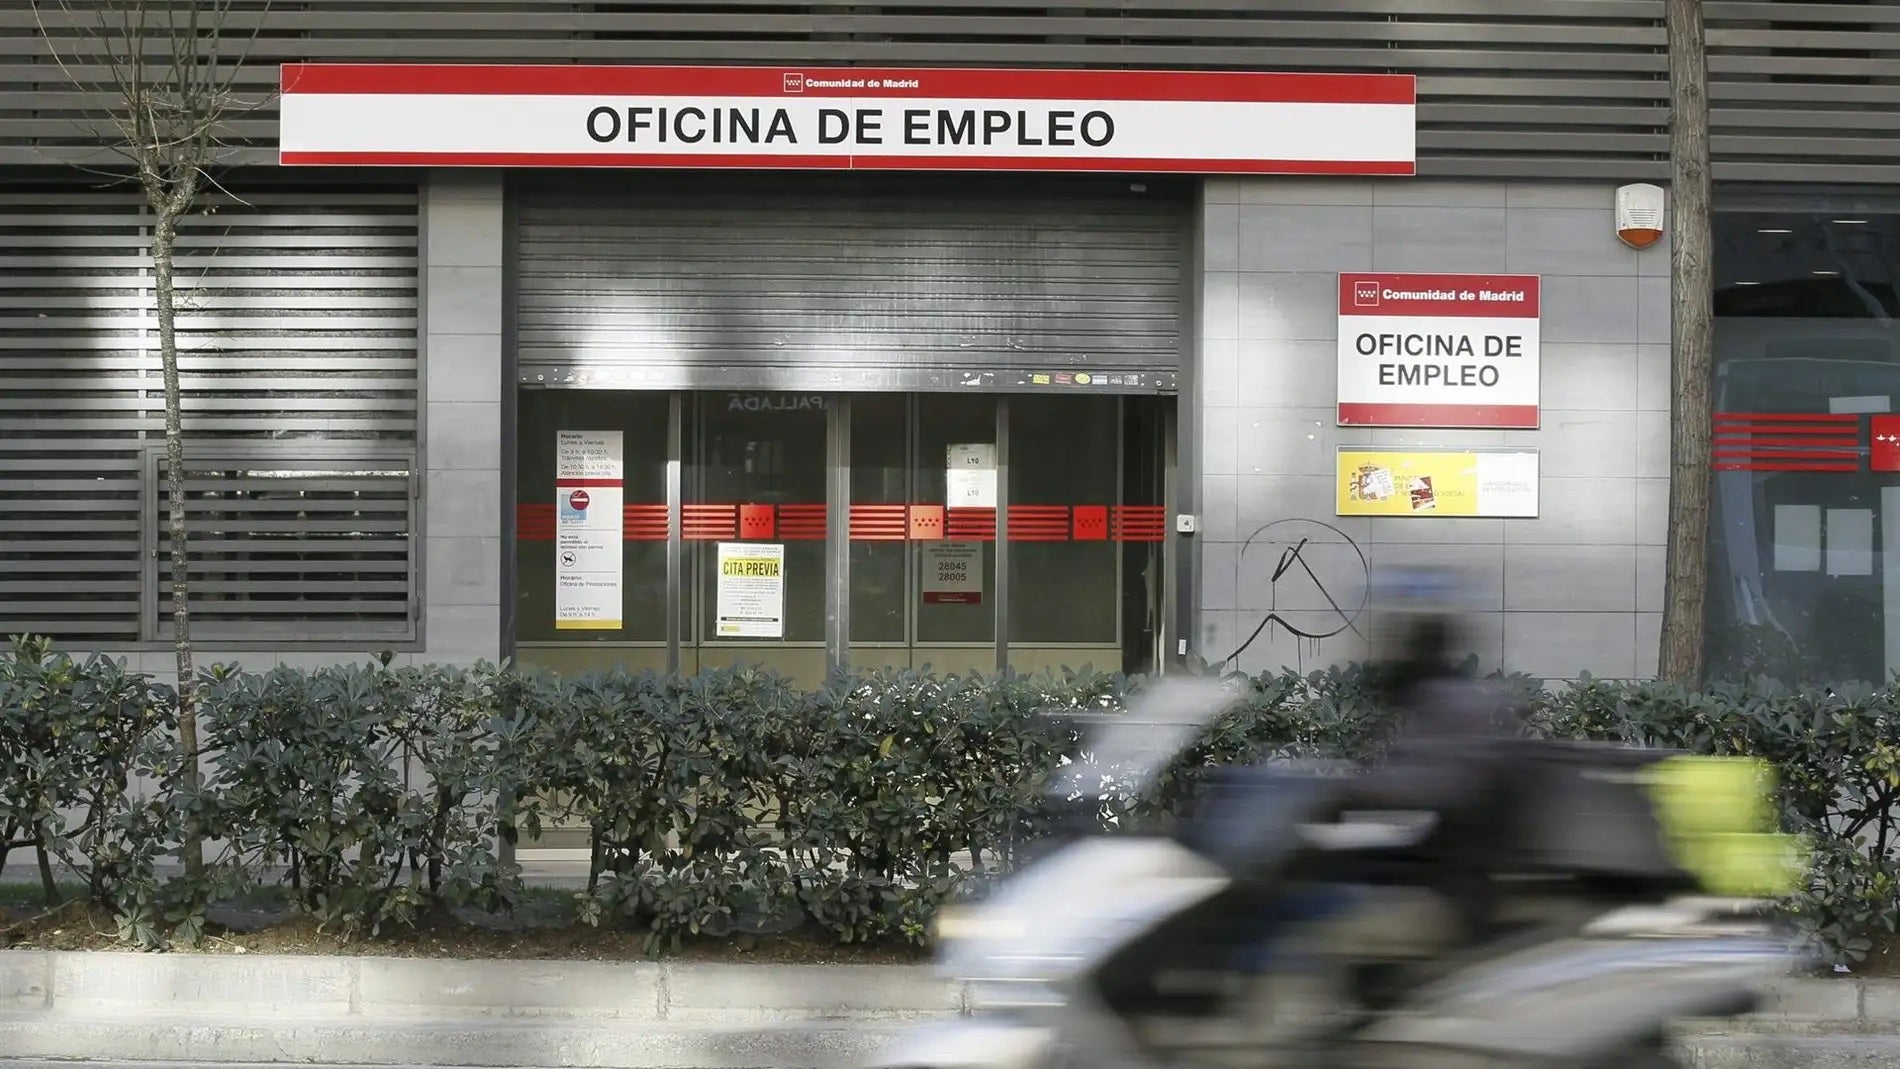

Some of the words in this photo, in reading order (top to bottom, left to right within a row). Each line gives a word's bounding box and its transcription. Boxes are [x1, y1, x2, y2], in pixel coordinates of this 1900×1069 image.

[806, 78, 864, 88] Comunidad
[867, 79, 880, 88] de
[883, 79, 918, 88] Madrid
[586, 106, 798, 144] OFICINA
[818, 108, 883, 145] DE
[903, 109, 1115, 148] EMPLEO
[1382, 289, 1456, 300] Comunidad
[1460, 290, 1475, 300] de
[1479, 291, 1524, 302] Madrid
[1356, 333, 1474, 356] OFICINA
[1484, 335, 1522, 357] DE
[1379, 364, 1499, 386] EMPLEO
[724, 562, 743, 575] CITA
[746, 562, 779, 576] PREVIA
[938, 562, 966, 571] 28045
[938, 572, 966, 582] 28005
